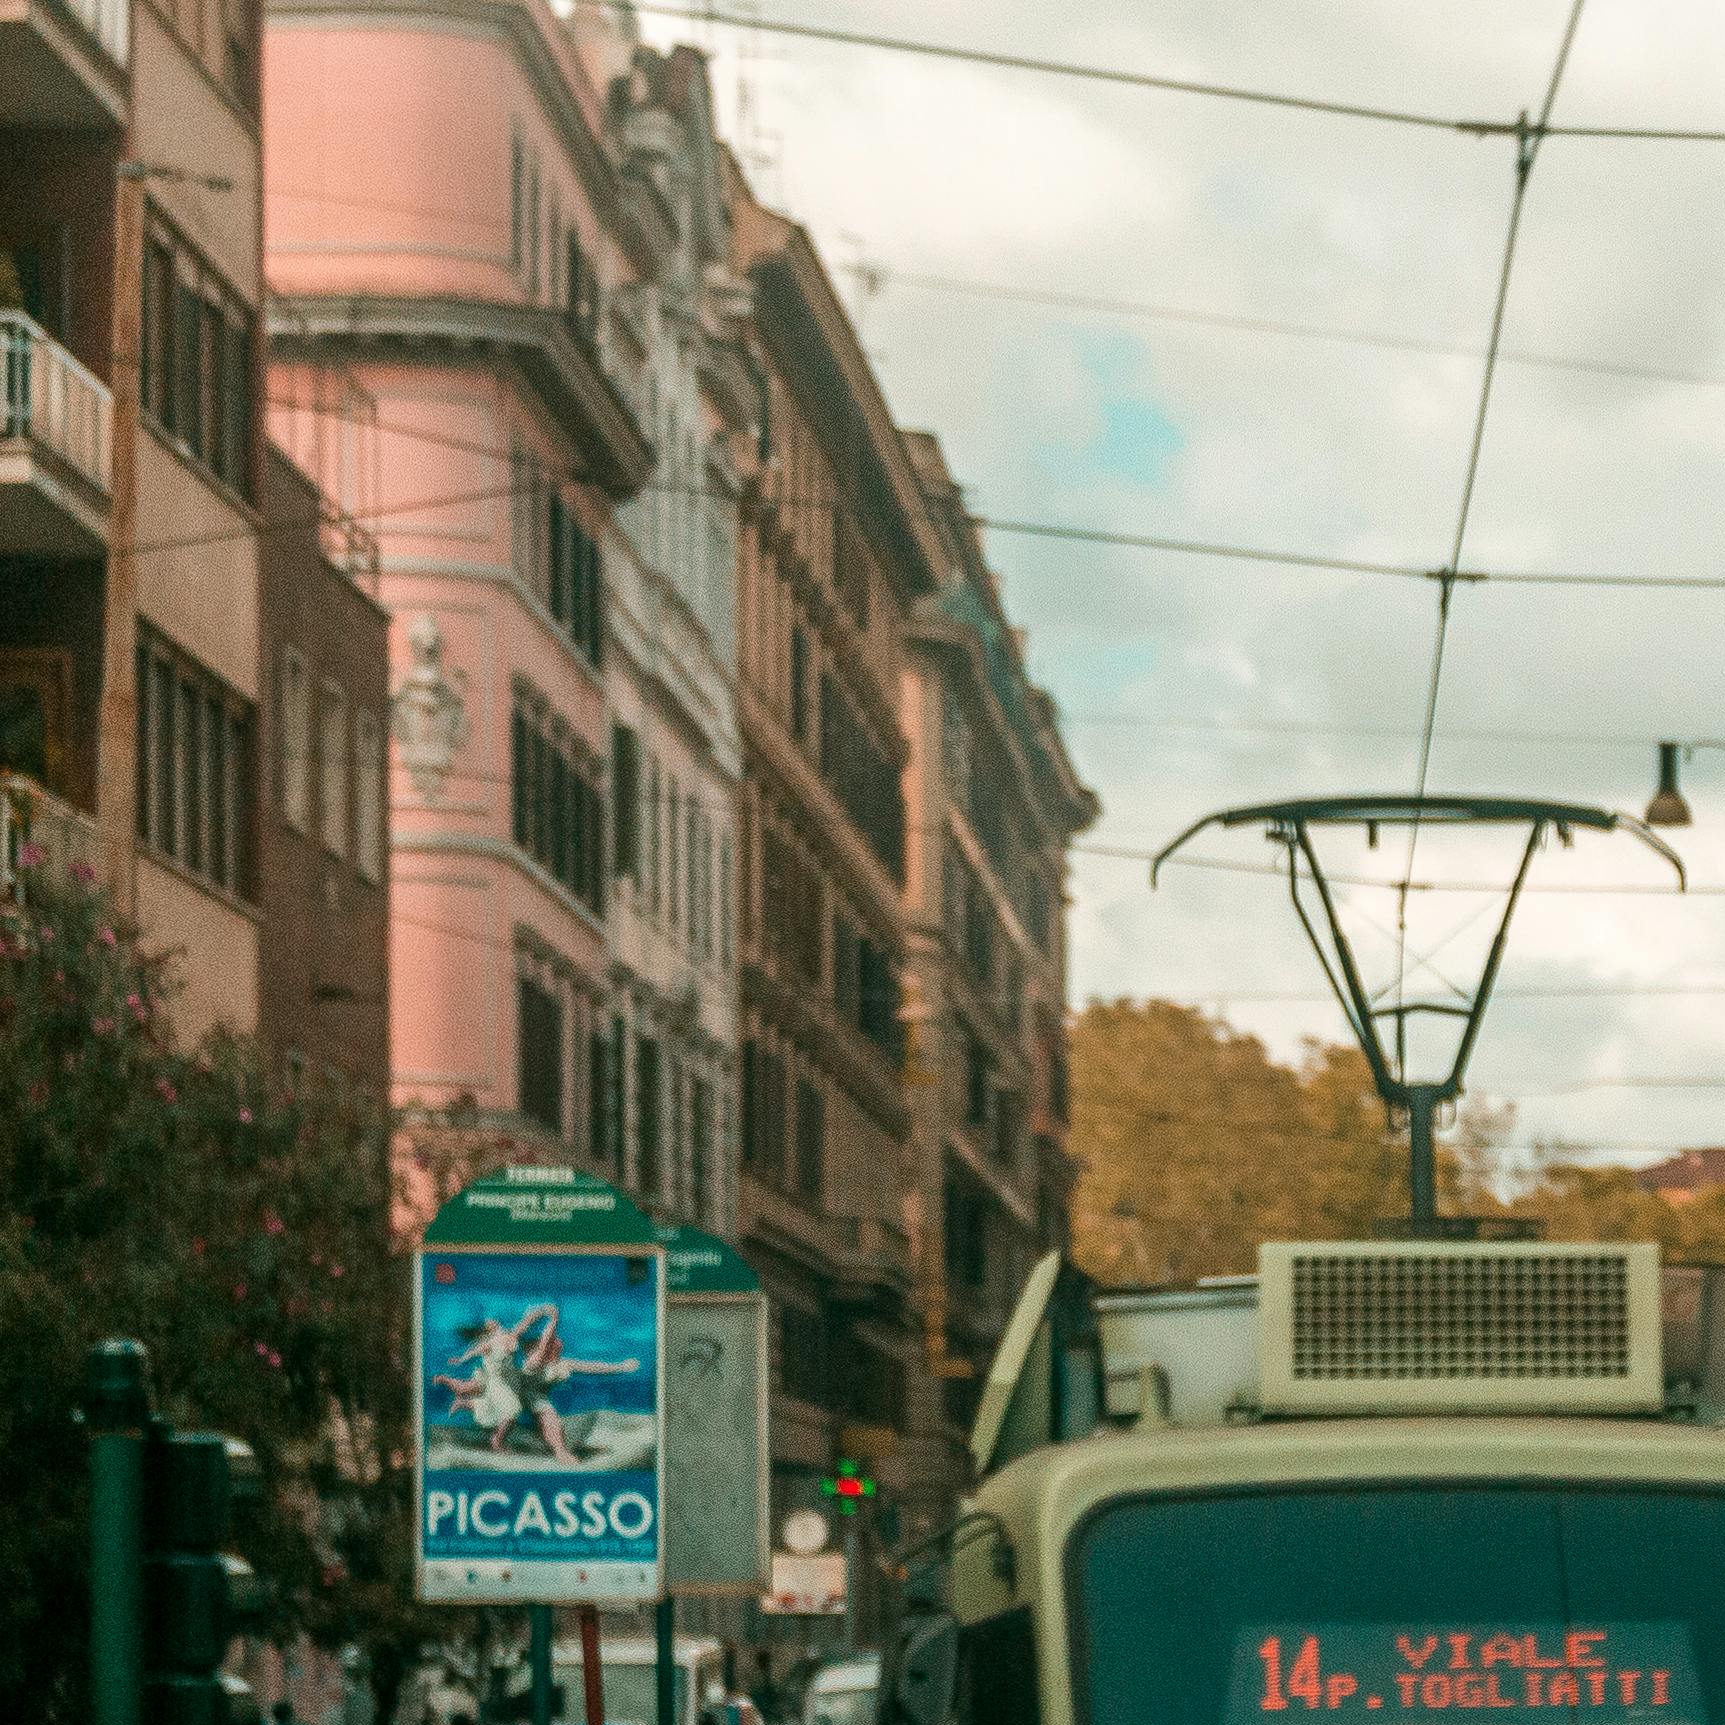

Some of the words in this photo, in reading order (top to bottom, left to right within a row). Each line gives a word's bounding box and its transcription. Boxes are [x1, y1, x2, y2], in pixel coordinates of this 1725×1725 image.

[426, 1490, 655, 1538] PICASSO
[1396, 1631, 1608, 1669] VIALE
[1394, 1669, 1672, 1709] TOGLIATTI
